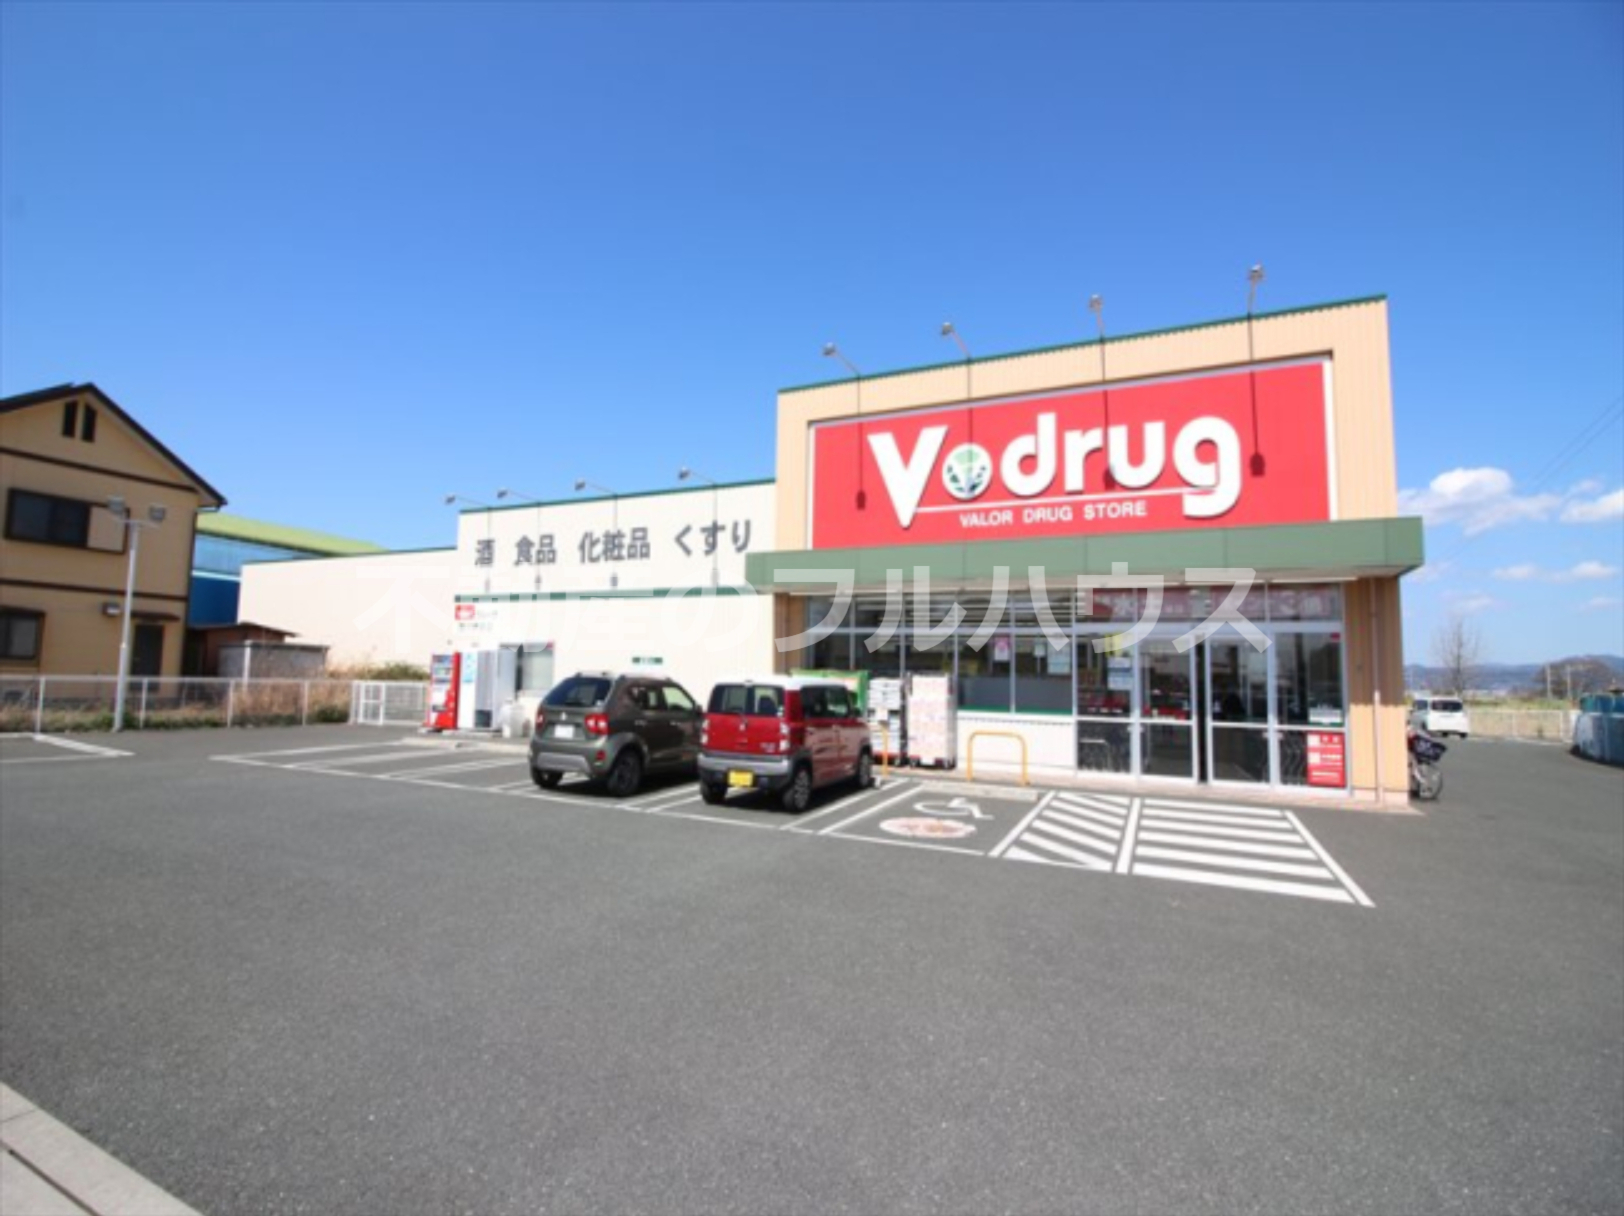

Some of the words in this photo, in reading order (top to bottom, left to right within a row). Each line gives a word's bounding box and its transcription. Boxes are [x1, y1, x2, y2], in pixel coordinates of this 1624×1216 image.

[960, 510, 1014, 528] VALOR
[1022, 507, 1073, 524] DRUG
[1083, 501, 1147, 521] STORE
[475, 538, 495, 567] 酒
[514, 534, 557, 567] 食品
[578, 527, 651, 564] 化粧品
[674, 519, 752, 557] くすり
